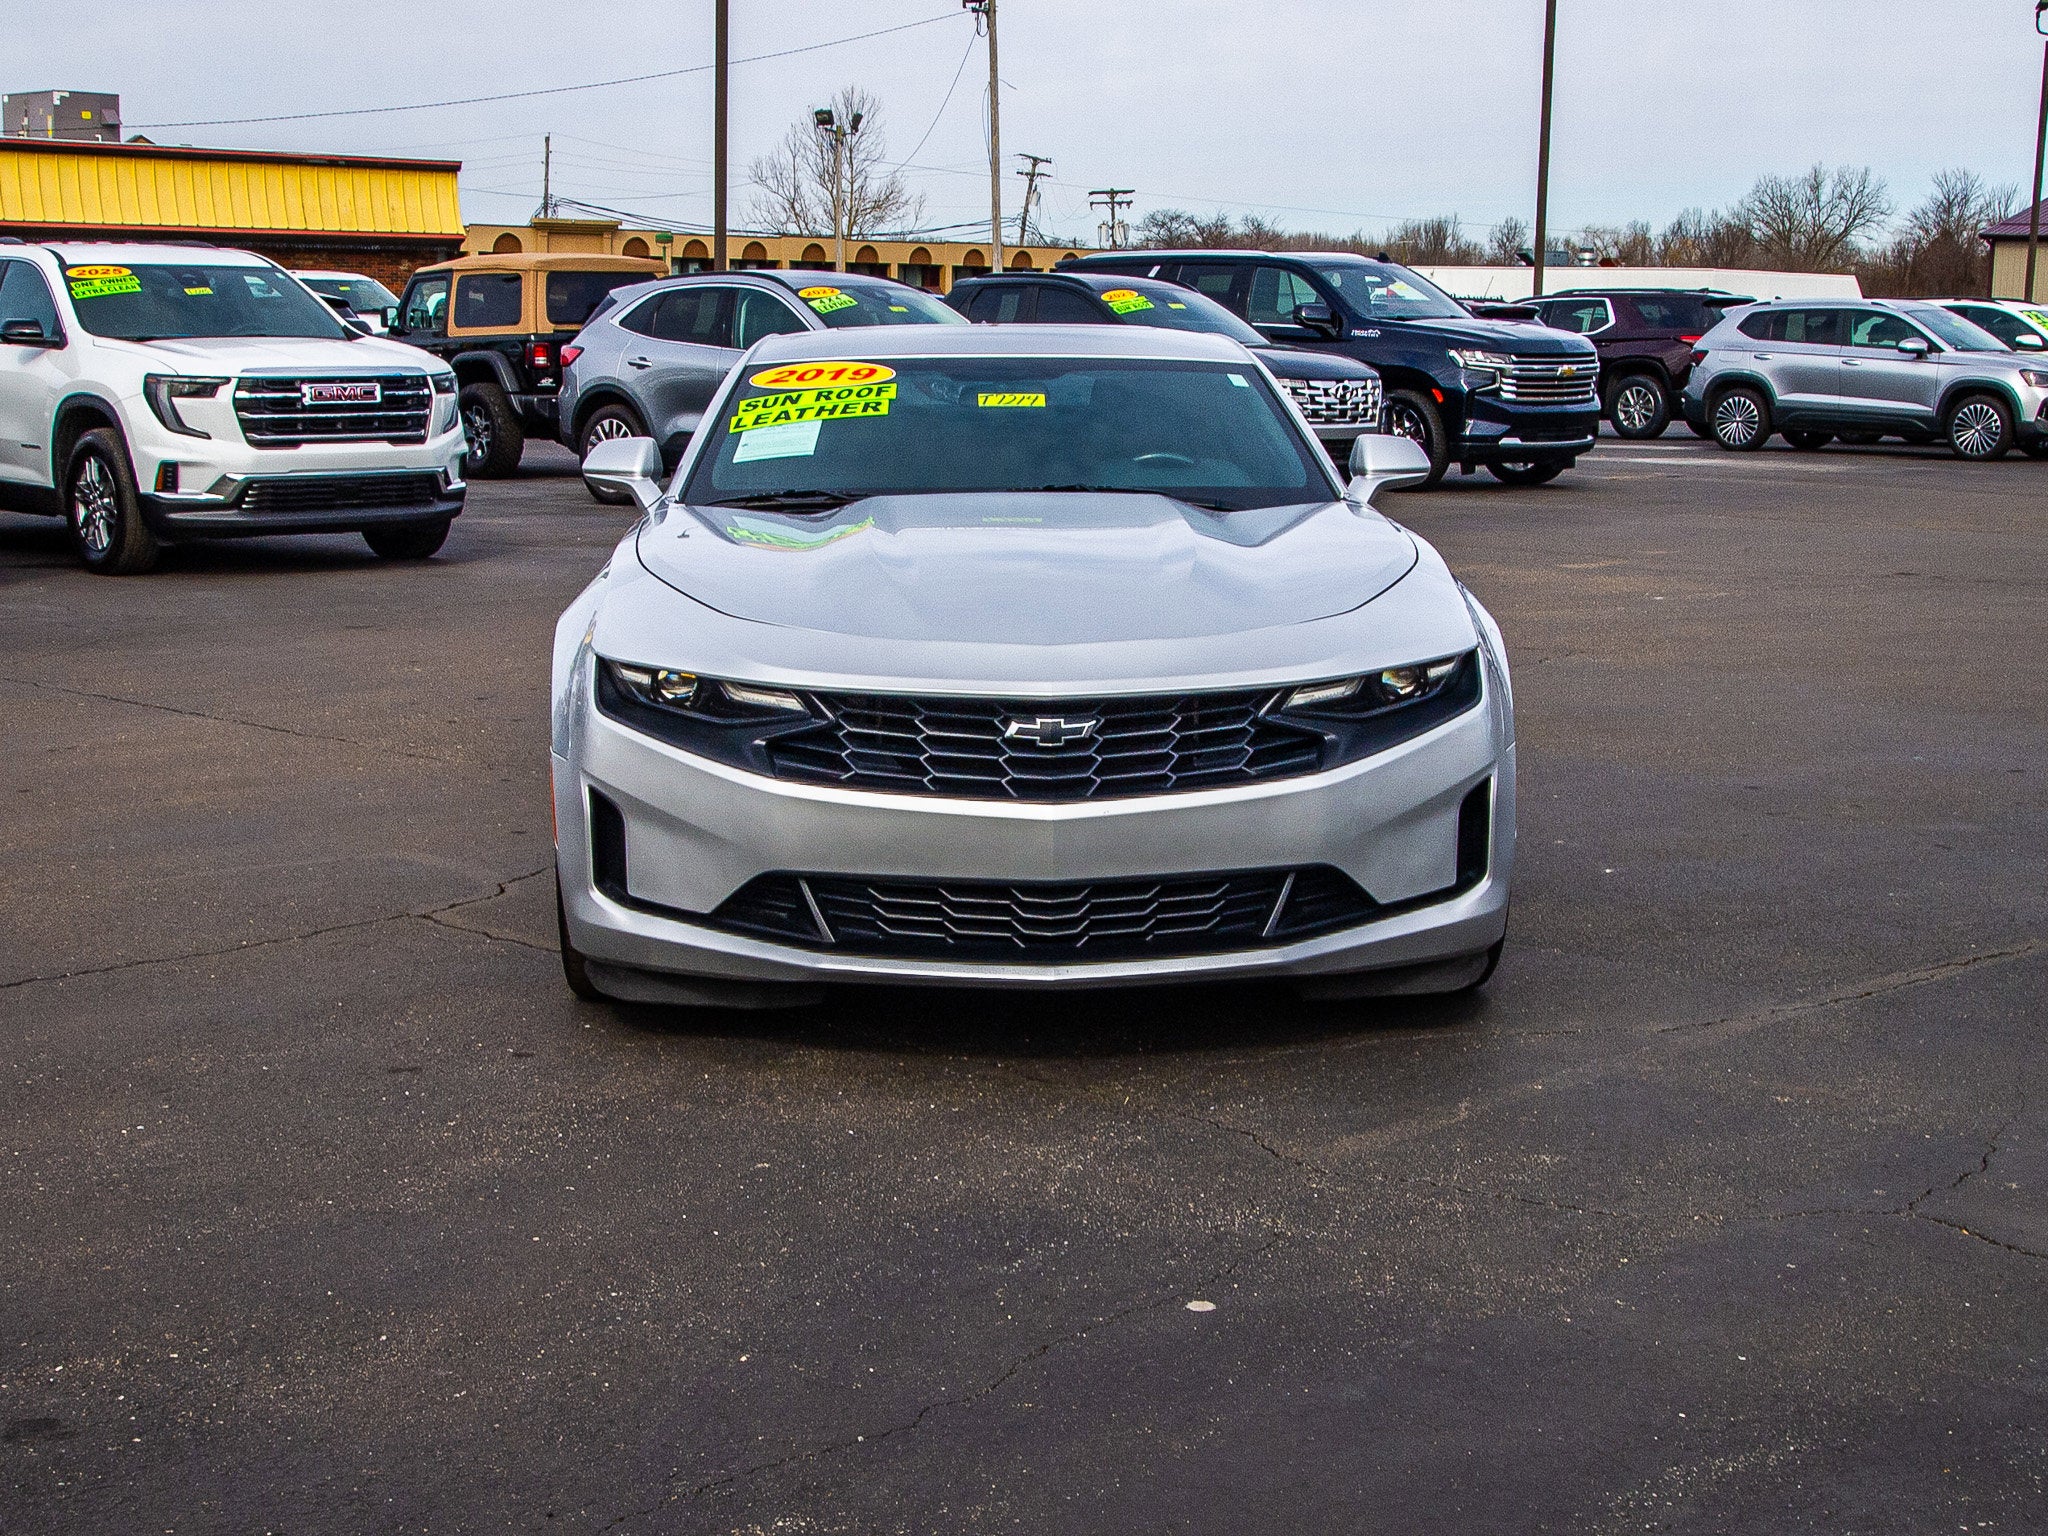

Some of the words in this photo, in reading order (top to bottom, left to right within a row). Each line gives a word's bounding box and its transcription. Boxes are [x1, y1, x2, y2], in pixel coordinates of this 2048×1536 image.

[76, 268, 123, 276] 2025
[75, 288, 105, 297] EXTRA
[107, 284, 137, 292] CLEAN
[765, 367, 879, 385] 2019
[312, 387, 378, 402] GMC
[741, 392, 804, 413] SUN
[814, 385, 893, 402] ROOF
[732, 401, 884, 430] LEATHER
